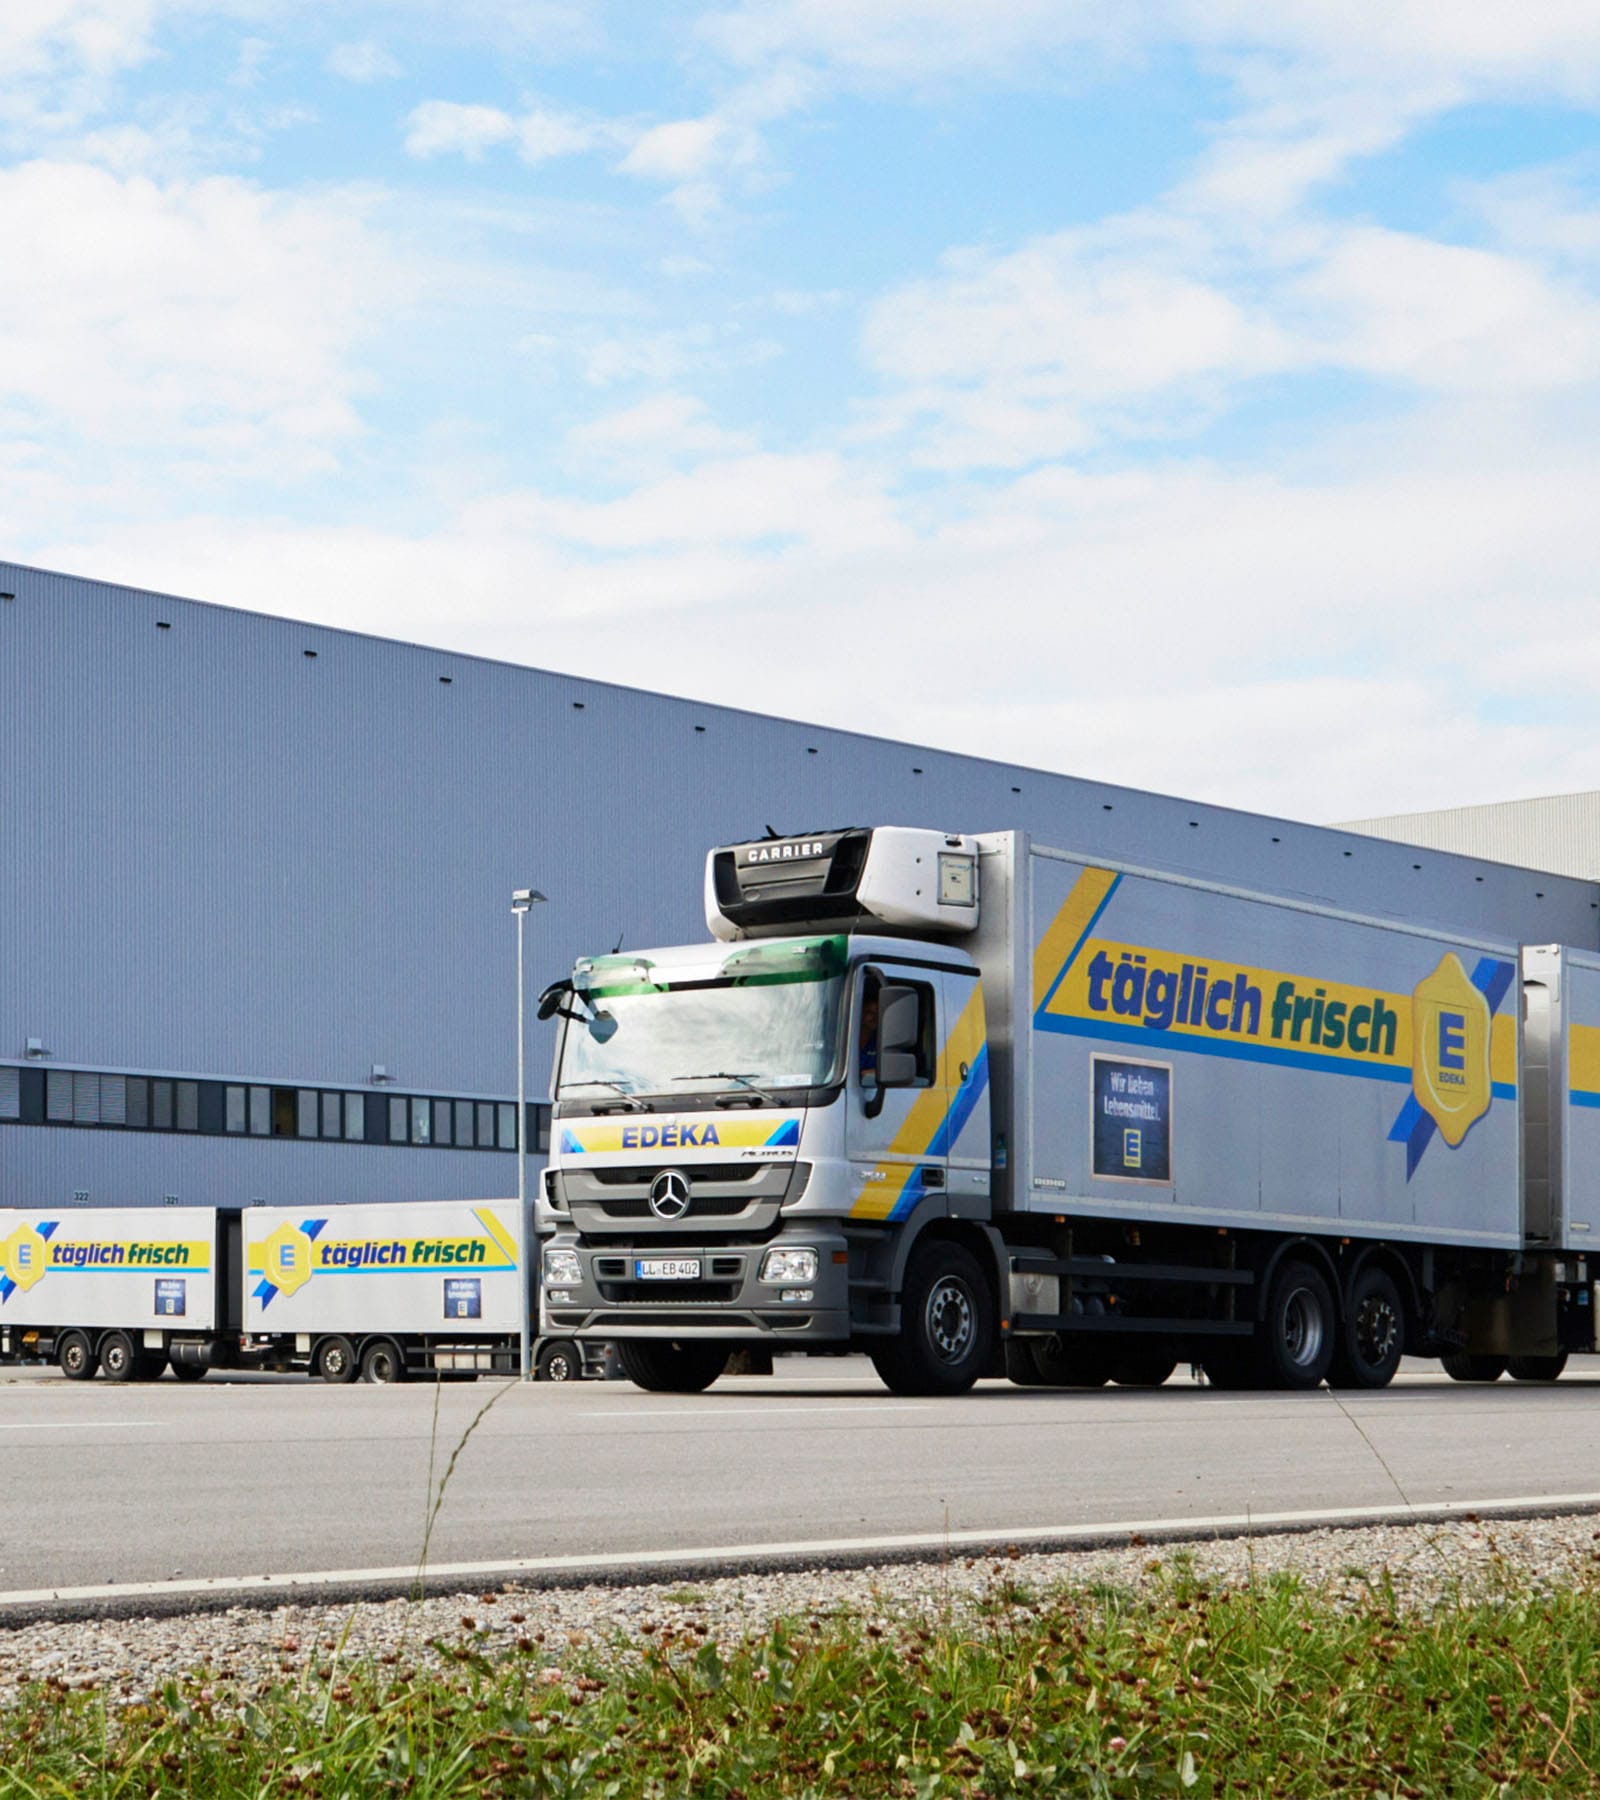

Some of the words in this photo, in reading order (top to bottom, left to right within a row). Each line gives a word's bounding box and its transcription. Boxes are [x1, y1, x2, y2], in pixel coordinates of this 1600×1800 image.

[748, 842, 822, 862] CARRIER
[1088, 951, 1262, 1035] täglich
[1271, 981, 1397, 1056] frisch
[1439, 1011, 1464, 1070] E
[1110, 1072, 1126, 1093] Wir
[1439, 1072, 1465, 1086] EDEKA
[622, 1124, 720, 1148] EDEKA
[1126, 1132, 1139, 1157] E
[74, 1192, 89, 1201] 322
[166, 1195, 179, 1205] 321
[19, 1245, 31, 1264] E
[52, 1243, 125, 1266] täglich
[128, 1243, 189, 1264] frisch
[280, 1245, 295, 1266] E
[321, 1241, 406, 1267] täglich
[412, 1240, 485, 1263] frisch
[643, 1263, 656, 1275] LL
[662, 1263, 676, 1275] EB
[678, 1263, 698, 1275] 402
